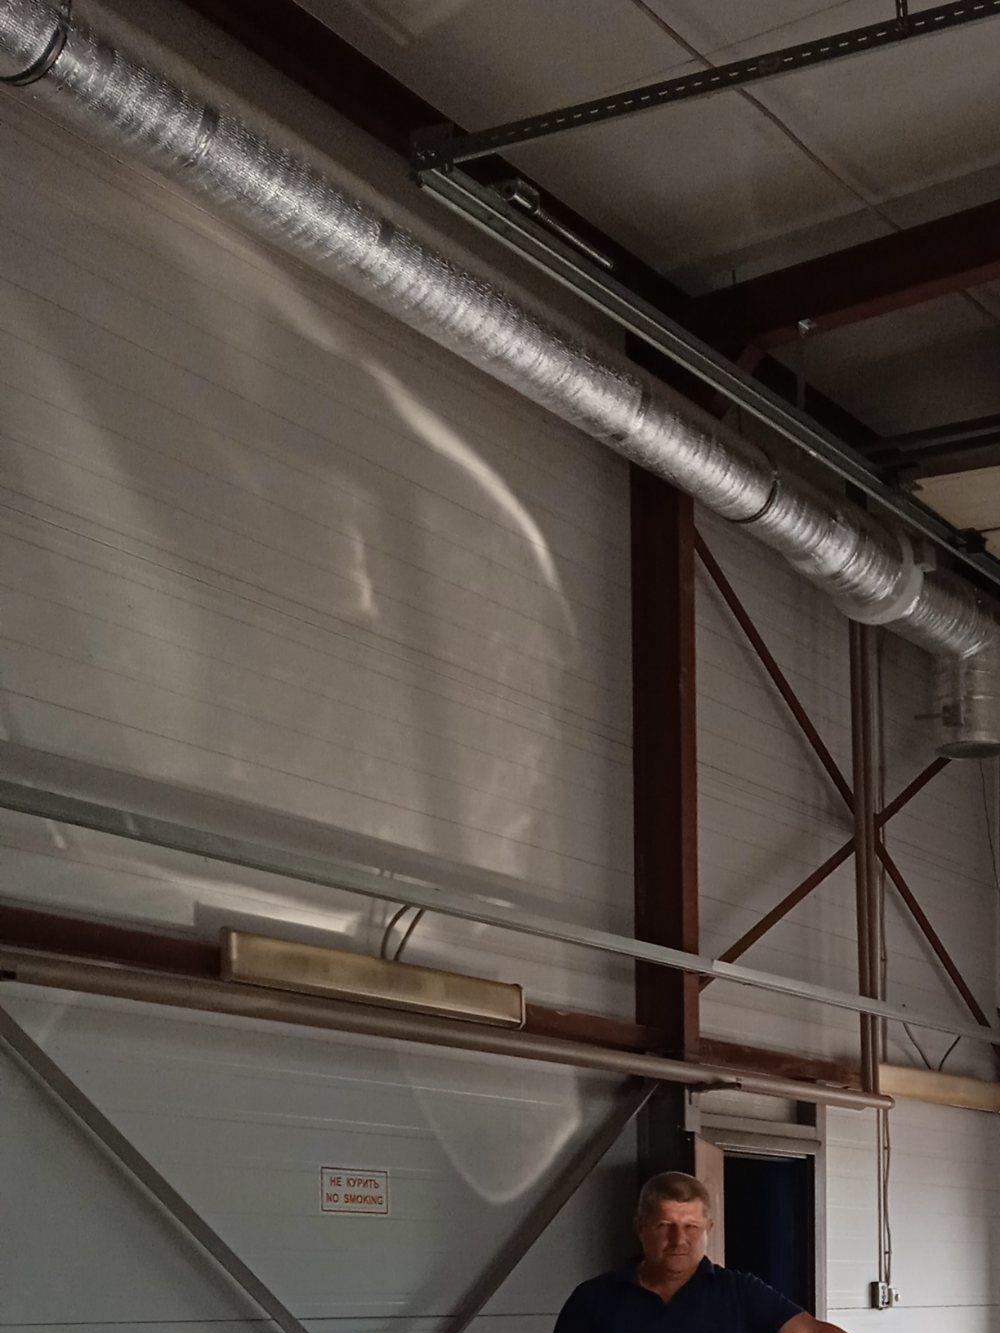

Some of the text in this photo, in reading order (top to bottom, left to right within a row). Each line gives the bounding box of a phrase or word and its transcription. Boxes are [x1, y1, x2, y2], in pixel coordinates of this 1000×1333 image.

[330, 1176, 380, 1189] НЕ КУРИТЬ
[326, 1193, 384, 1205] NO SMOKING
